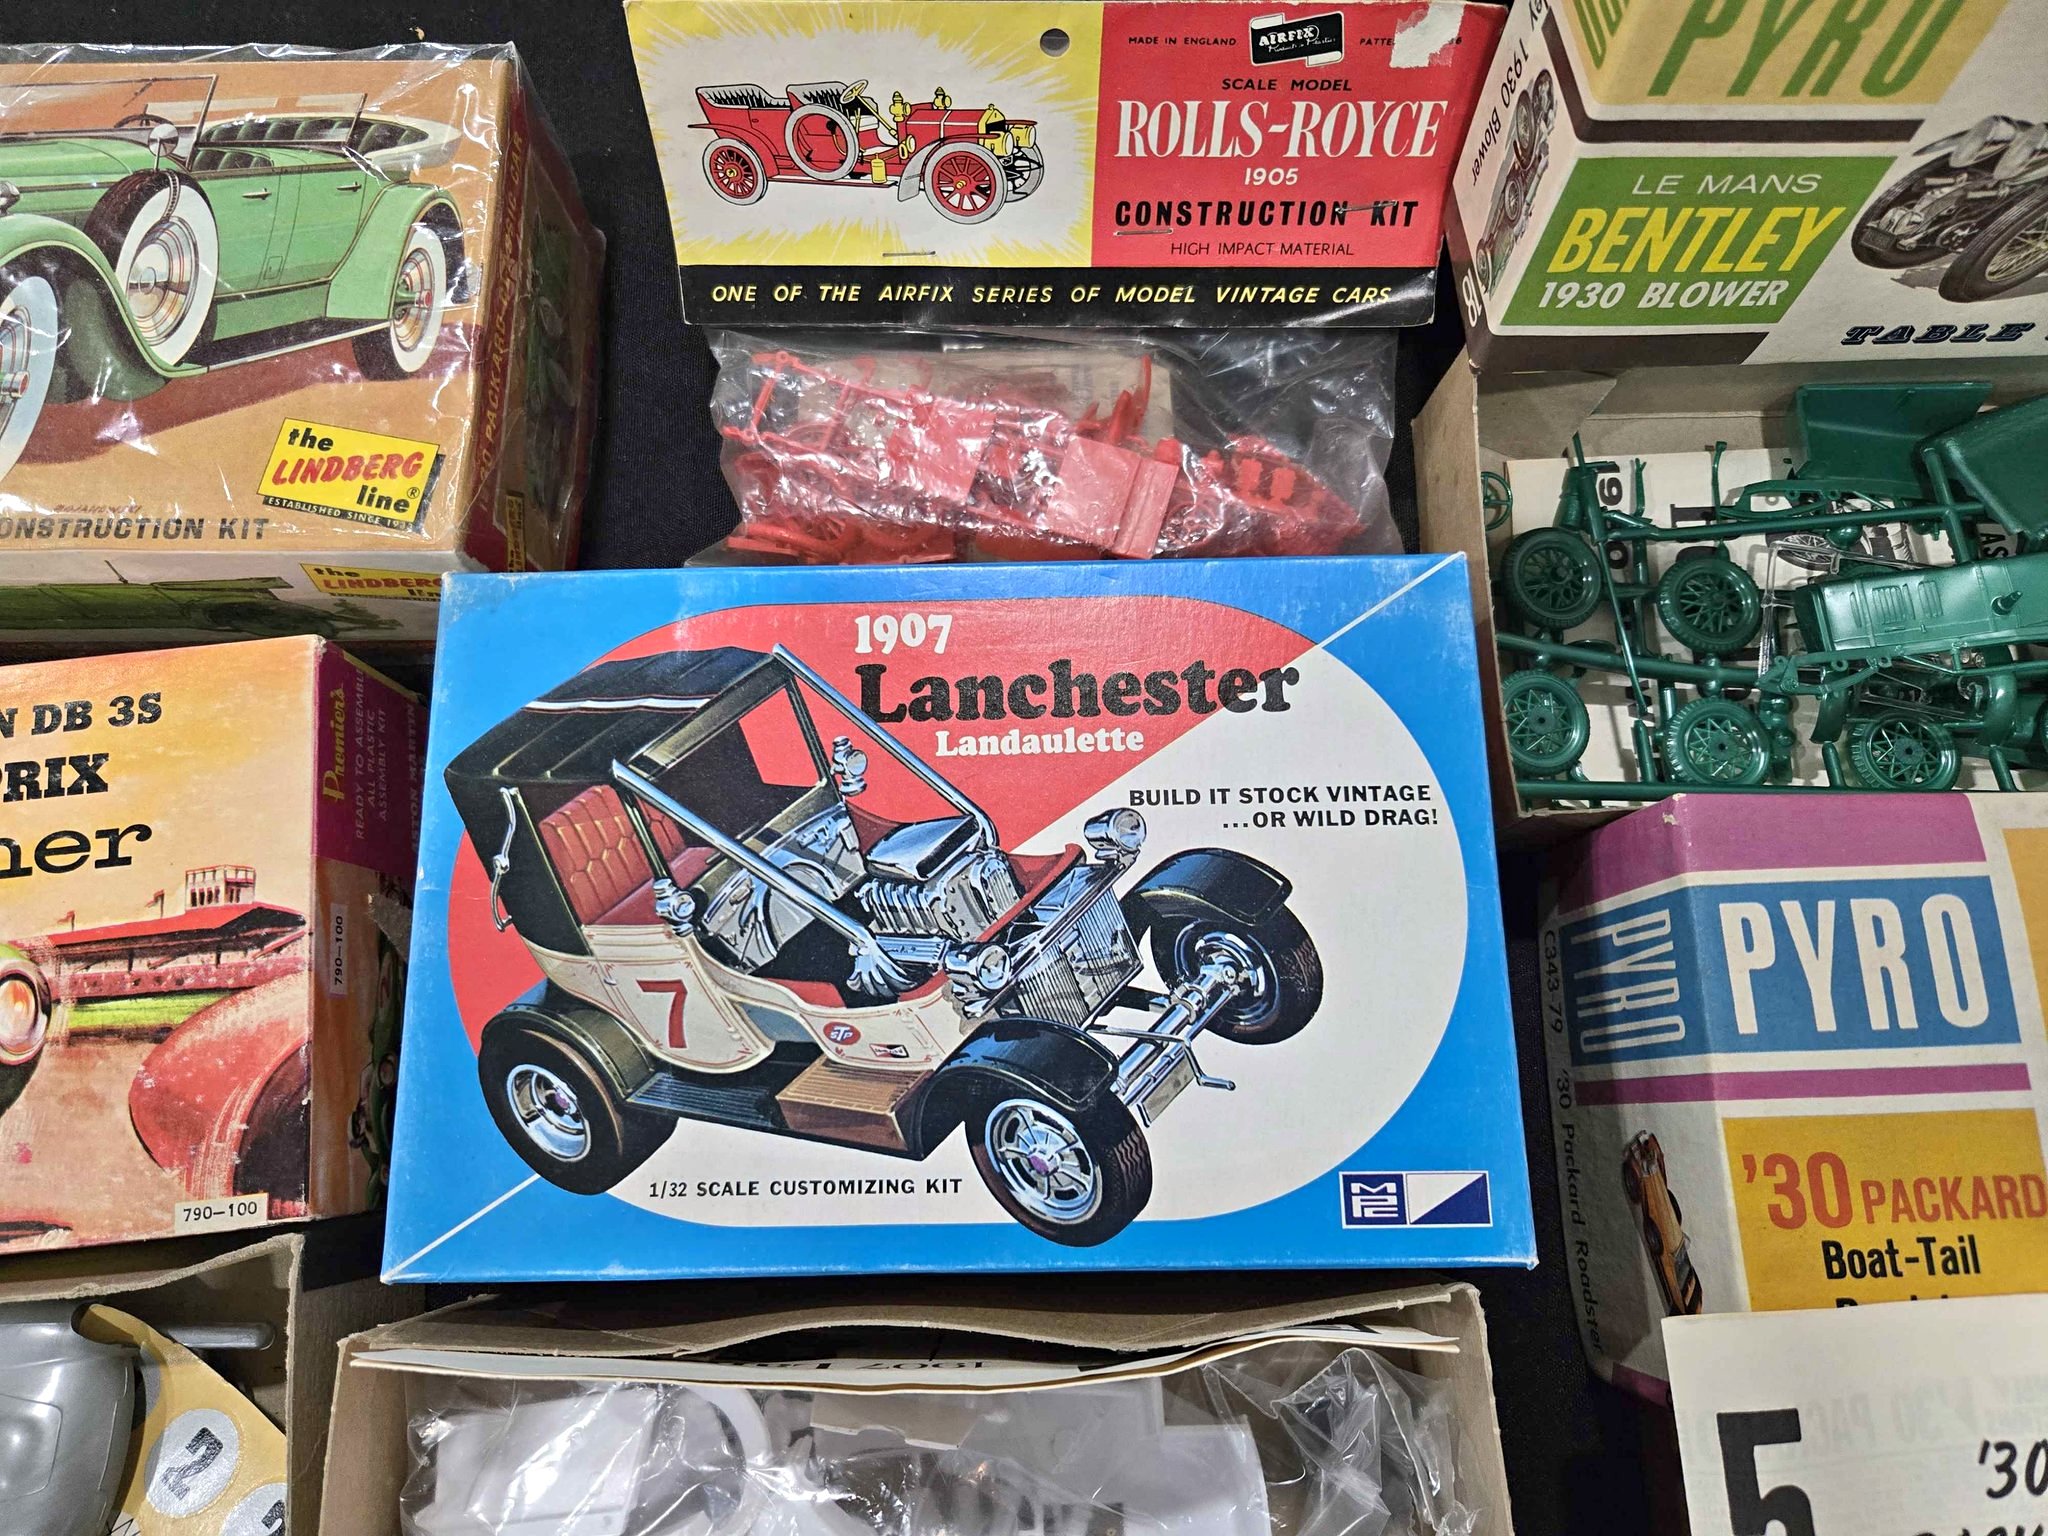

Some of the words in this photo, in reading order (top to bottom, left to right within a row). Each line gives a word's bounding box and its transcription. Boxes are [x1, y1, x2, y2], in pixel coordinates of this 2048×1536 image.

[1128, 36, 1159, 46] MADE
[1164, 36, 1177, 46] IN
[1183, 37, 1237, 46] ENGLAND
[1259, 27, 1315, 46] AIRFIX
[1360, 38, 1396, 46] PATTE
[1647, 0, 1965, 97] PYRO
[1222, 78, 1277, 91] SCALE
[1291, 78, 1352, 91] MODEL
[1500, 38, 1529, 109] 1930
[1114, 99, 1449, 158] ROLLS-ROYCE
[1471, 106, 1501, 187] Blower
[511, 131, 523, 185] CAR
[1244, 167, 1299, 186] 1905
[1632, 174, 1684, 195] LE
[1696, 173, 1823, 195] MANS
[1115, 200, 1348, 227] CONSTRUCTION
[1370, 199, 1419, 227] KIT
[1171, 242, 1210, 255] HIGH
[1218, 242, 1275, 255] IMPACT
[1280, 242, 1354, 256] MATERIAL
[1546, 206, 1847, 274] BENTLEY
[712, 285, 757, 302] ONE
[773, 285, 803, 302] OF
[819, 285, 862, 302] THE
[879, 286, 954, 302] AIRFIX
[972, 286, 1053, 303] SERIES
[1071, 287, 1100, 302] OF
[1114, 286, 1196, 303] MODEL
[1216, 287, 1320, 303] VINTAGE
[1332, 287, 1391, 303] CARS
[1538, 281, 1626, 309] 1930
[1637, 280, 1790, 309] BLOWER
[1841, 322, 2036, 345] TABLE
[288, 428, 334, 451] the
[271, 451, 424, 486] LINDBERG
[0, 516, 205, 540] ONSTRUCTION
[218, 516, 270, 540] KIT
[268, 497, 341, 517] ESTABLISHED
[347, 511, 381, 524] SINCE
[314, 567, 360, 578] the
[854, 613, 953, 655] 1907
[854, 658, 1300, 723] Lanchester
[31, 700, 93, 735] DB
[107, 692, 162, 727] 3S
[378, 709, 387, 734] KIT
[323, 682, 345, 803] Premier's
[367, 709, 377, 773] PLASTIC
[935, 727, 1144, 757] Landaulette
[0, 753, 109, 803] RIX
[355, 754, 365, 776] TO
[378, 740, 388, 822] ASSEMBLY
[355, 782, 366, 840] READY
[367, 781, 376, 809] ALL
[1129, 788, 1201, 807] BUILD
[1209, 788, 1231, 805] IT
[1239, 786, 1319, 804] STOCK
[1326, 785, 1431, 803] VINTAGE
[1223, 810, 1286, 829] ...OR
[1293, 810, 1356, 827] WILD
[1365, 809, 1438, 826] DRAG!
[1570, 908, 1686, 1054] PYRO
[1719, 893, 1990, 1035] PYRO
[636, 979, 688, 1049] 7
[649, 1181, 688, 1198] 1/32
[697, 1180, 760, 1197] SCALE
[770, 1178, 915, 1196] CUSTOMIZING
[926, 1178, 963, 1195] KIT
[1351, 1182, 1399, 1218] MPC
[1742, 1151, 1853, 1230] '30
[1860, 1174, 2048, 1225] PACKARD
[1562, 1123, 1586, 1226] Packard
[1575, 1240, 1602, 1352] Roadster
[1821, 1234, 1981, 1280] Boat-Tail
[159, 1427, 224, 1501] 2
[1716, 1408, 1816, 1536] 5
[1979, 1438, 2048, 1499] '30
